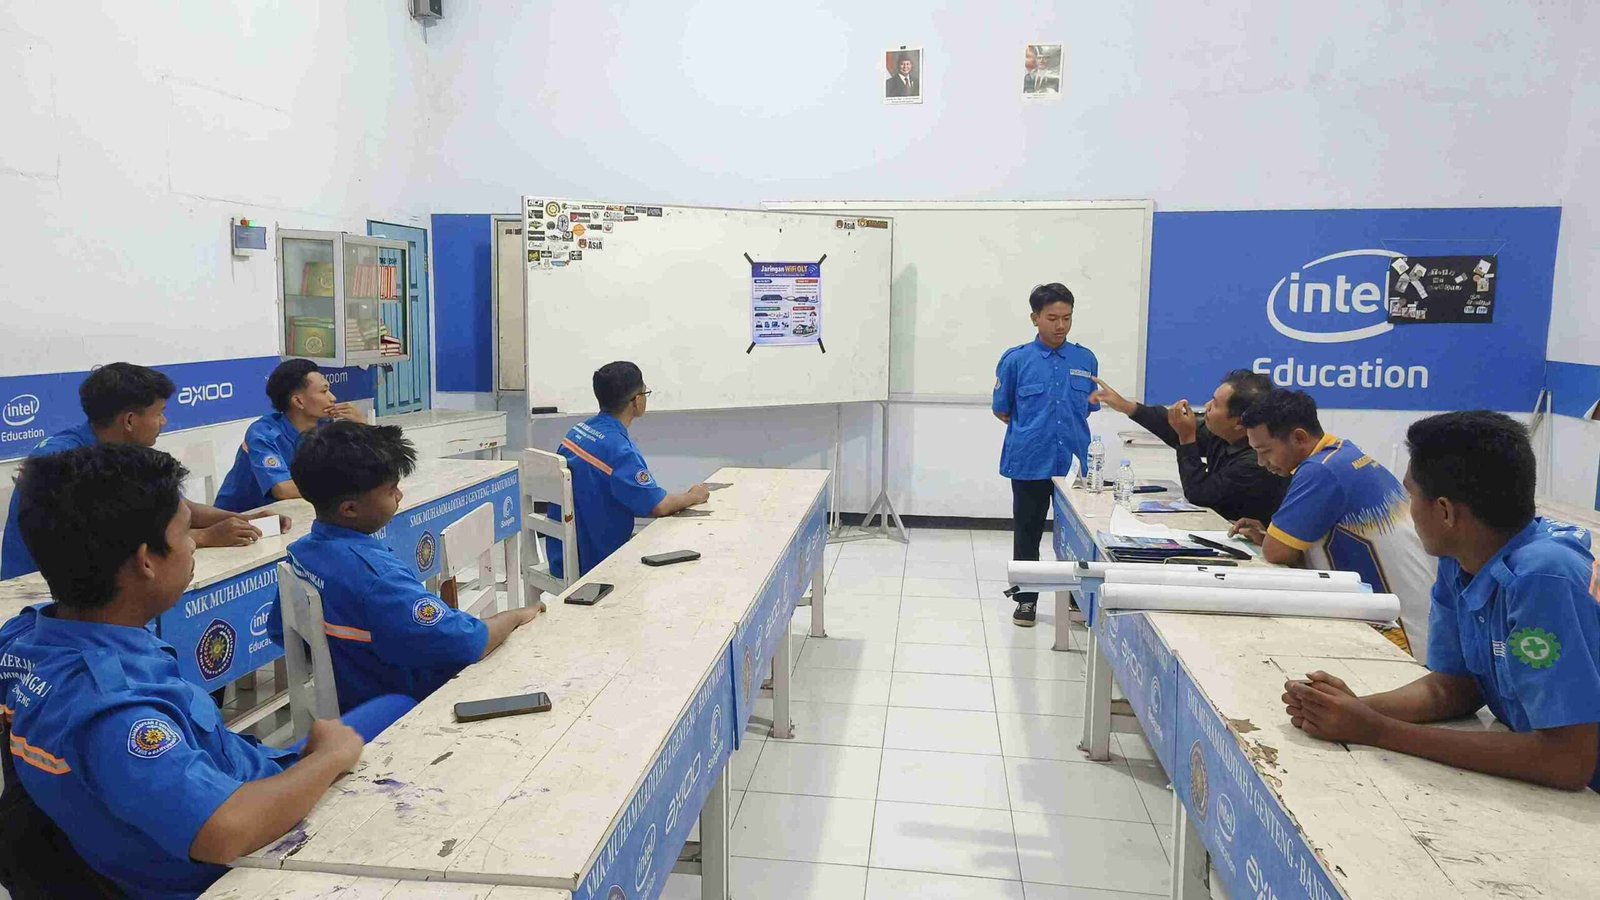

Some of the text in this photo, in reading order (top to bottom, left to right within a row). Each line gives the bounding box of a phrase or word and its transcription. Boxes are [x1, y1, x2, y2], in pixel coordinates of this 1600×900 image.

[761, 265, 784, 273] Jaringan
[1252, 357, 1428, 389] Education
[7, 401, 34, 418] intel
[1, 427, 45, 442] Education
[185, 595, 211, 619] SMK
[209, 568, 279, 609] MUHAMMADIY
[1254, 789, 1294, 868] GENTENG
